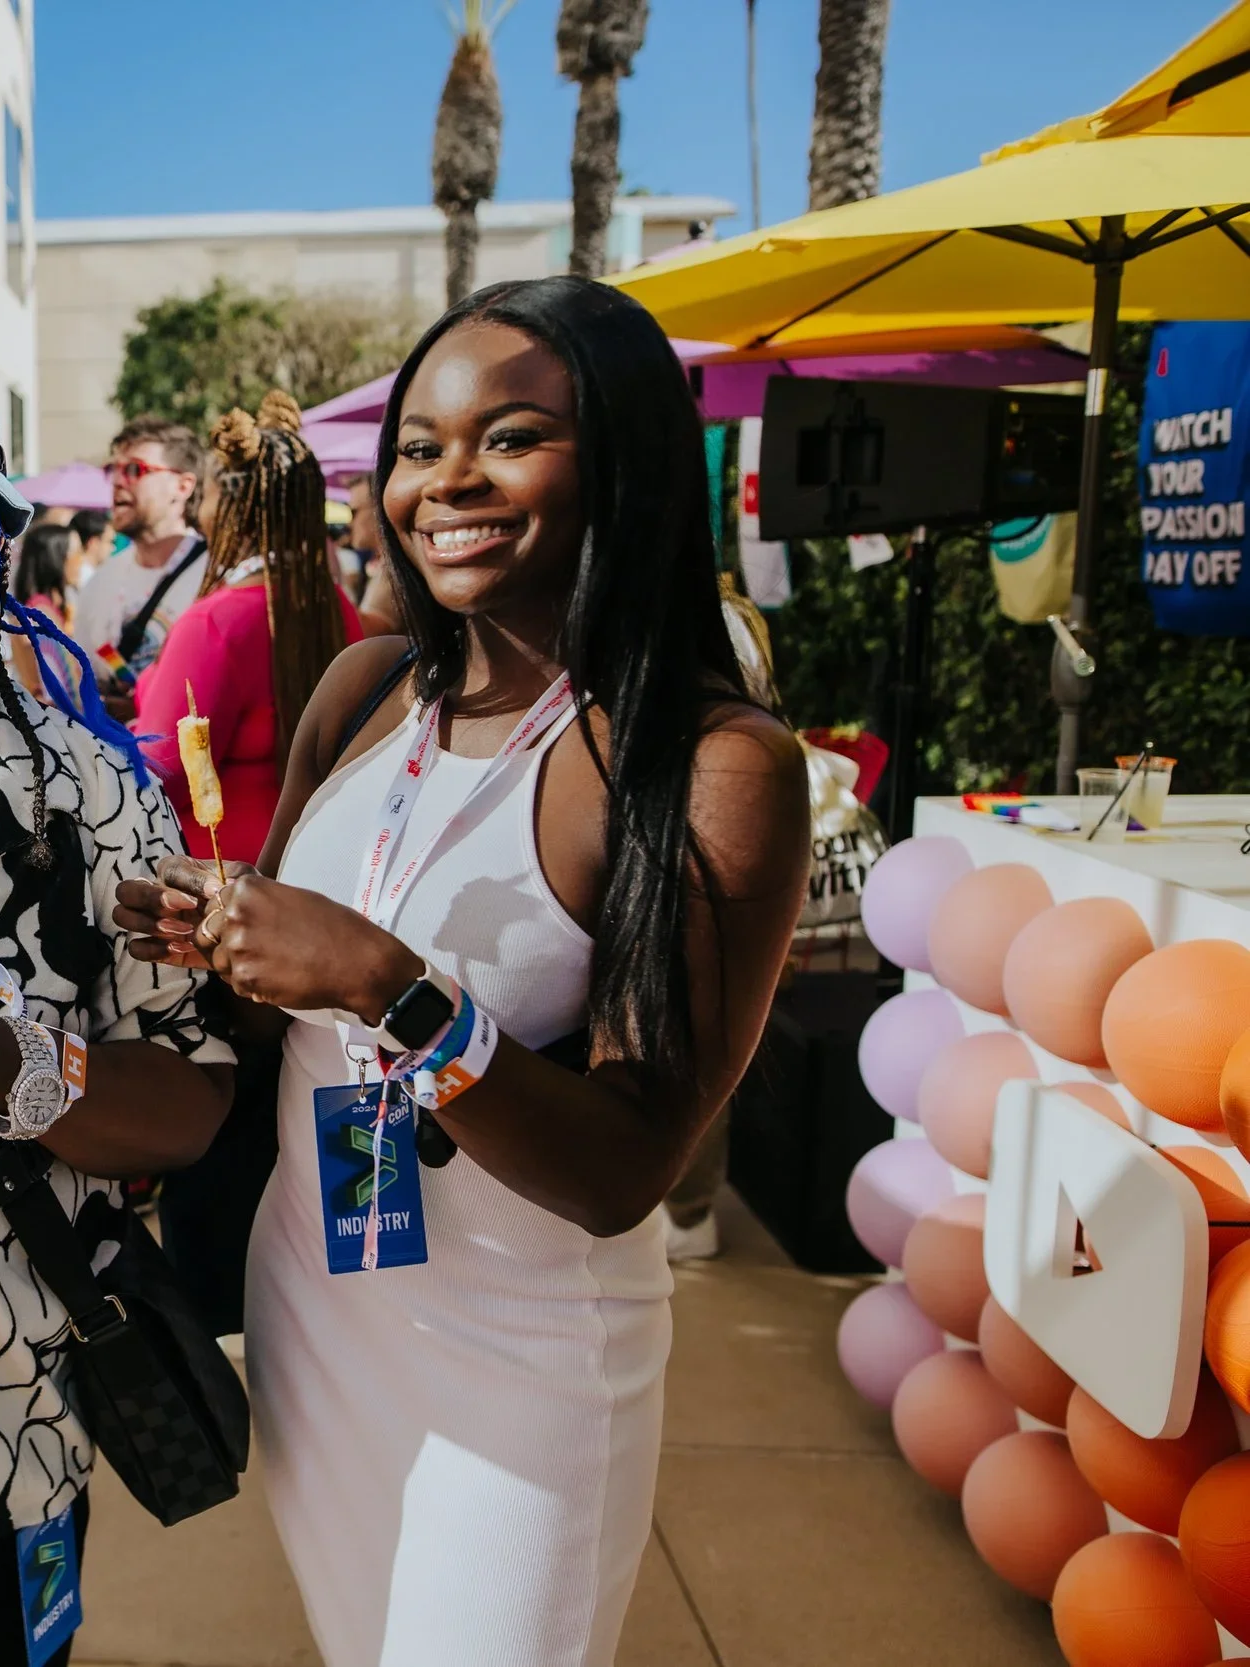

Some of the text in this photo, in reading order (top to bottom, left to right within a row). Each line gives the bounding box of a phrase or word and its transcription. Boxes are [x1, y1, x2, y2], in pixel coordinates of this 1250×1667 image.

[1154, 408, 1233, 453] WATCH
[1148, 458, 1206, 498] YOUR
[1142, 502, 1246, 541] PASSION
[1192, 549, 1243, 586] OFF
[352, 1105, 377, 1113] 2024
[388, 1103, 410, 1125] CON
[32, 1589, 74, 1642] INDUSTRY
